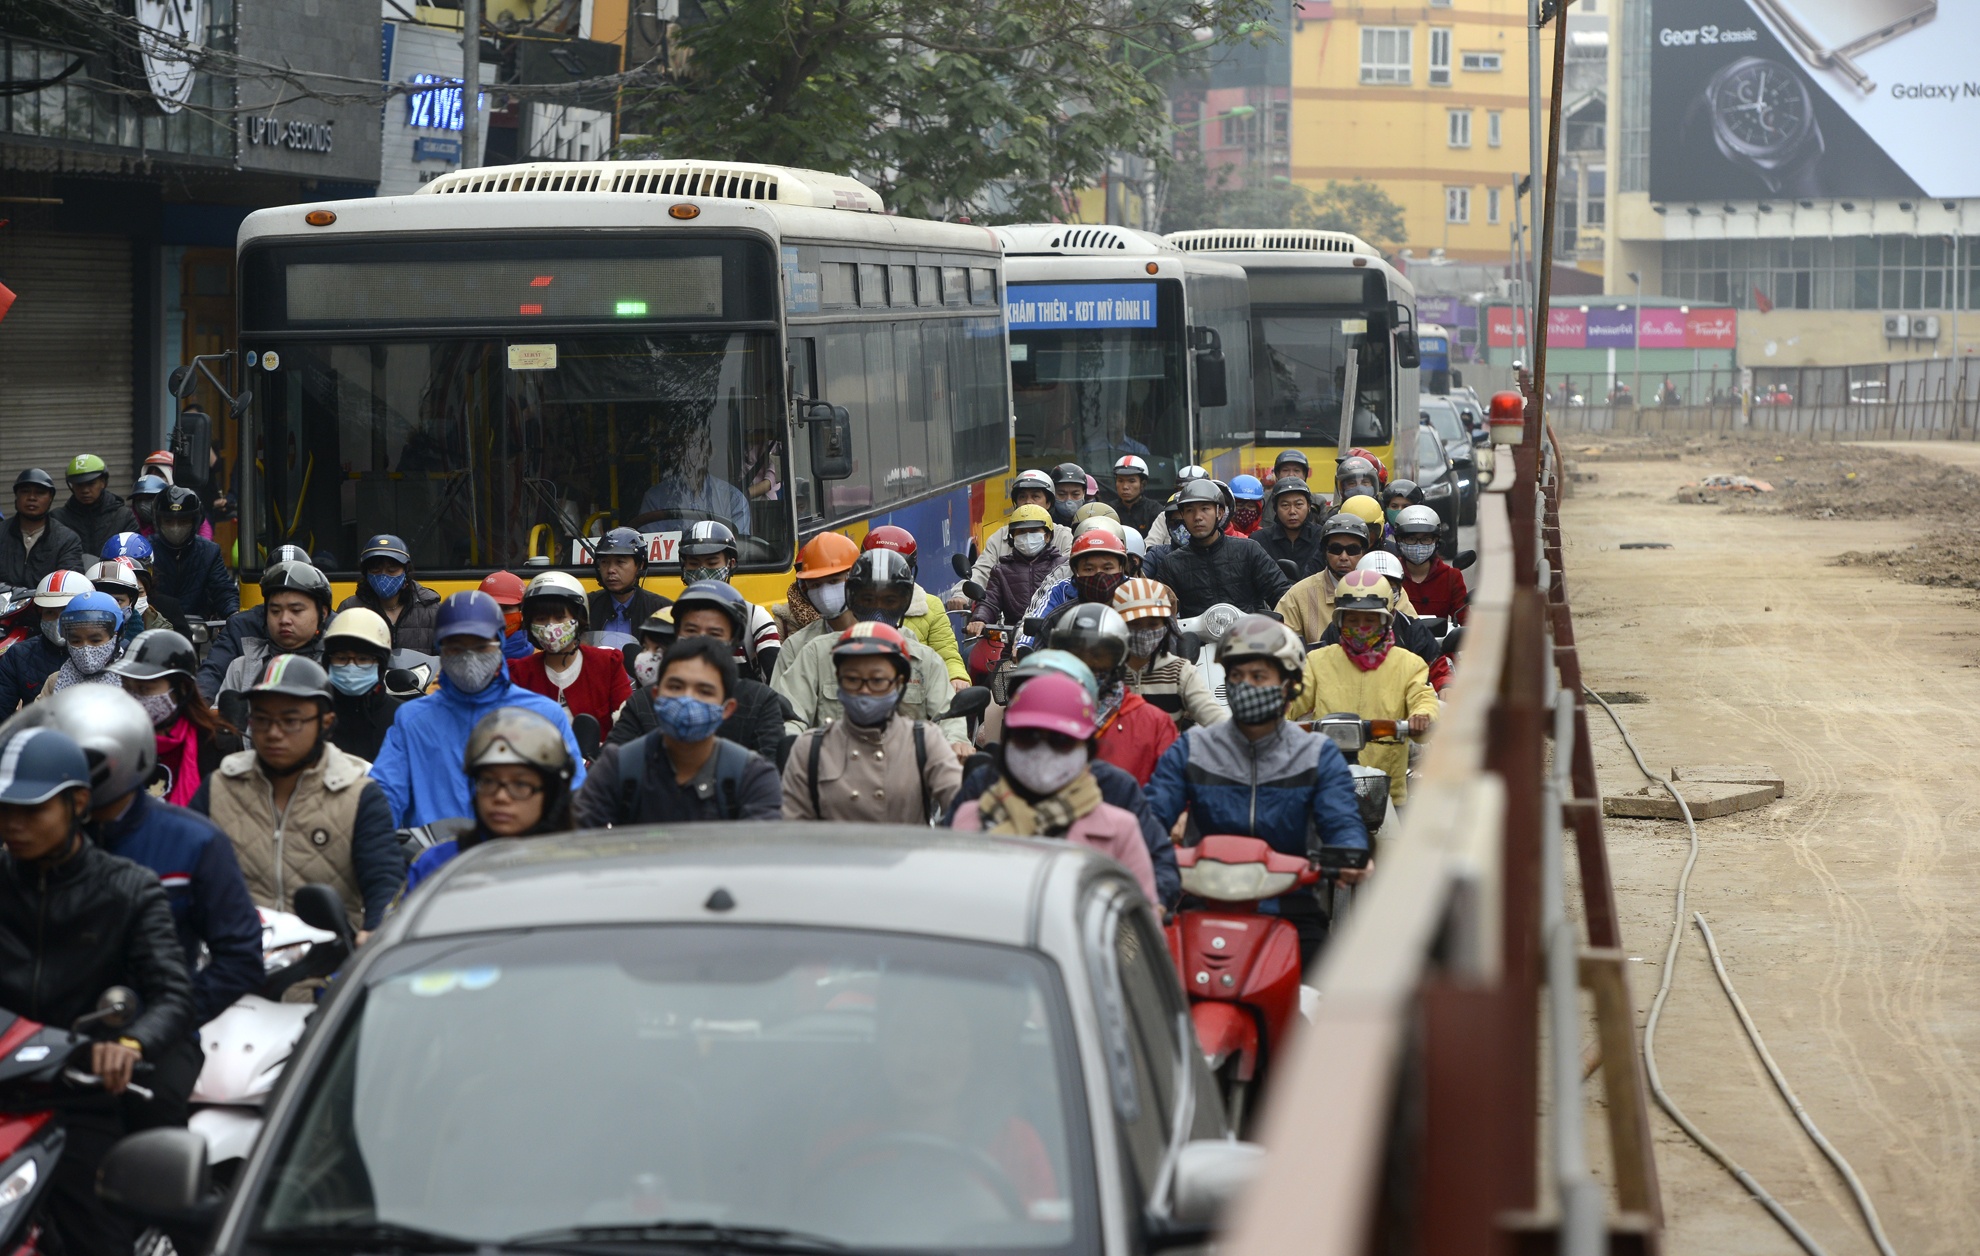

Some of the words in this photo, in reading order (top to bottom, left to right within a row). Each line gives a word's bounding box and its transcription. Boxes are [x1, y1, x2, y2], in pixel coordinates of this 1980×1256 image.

[1660, 27, 1699, 47] Gear
[1700, 24, 1719, 45] S2
[1720, 27, 1757, 43] classic
[1891, 82, 1959, 103] Galaxy
[1037, 298, 1067, 322] THIÊN
[1075, 301, 1095, 322] KĐT
[1097, 298, 1113, 321] MỸ
[1115, 297, 1140, 321] ĐÌNH
[646, 534, 675, 562] ẤY
